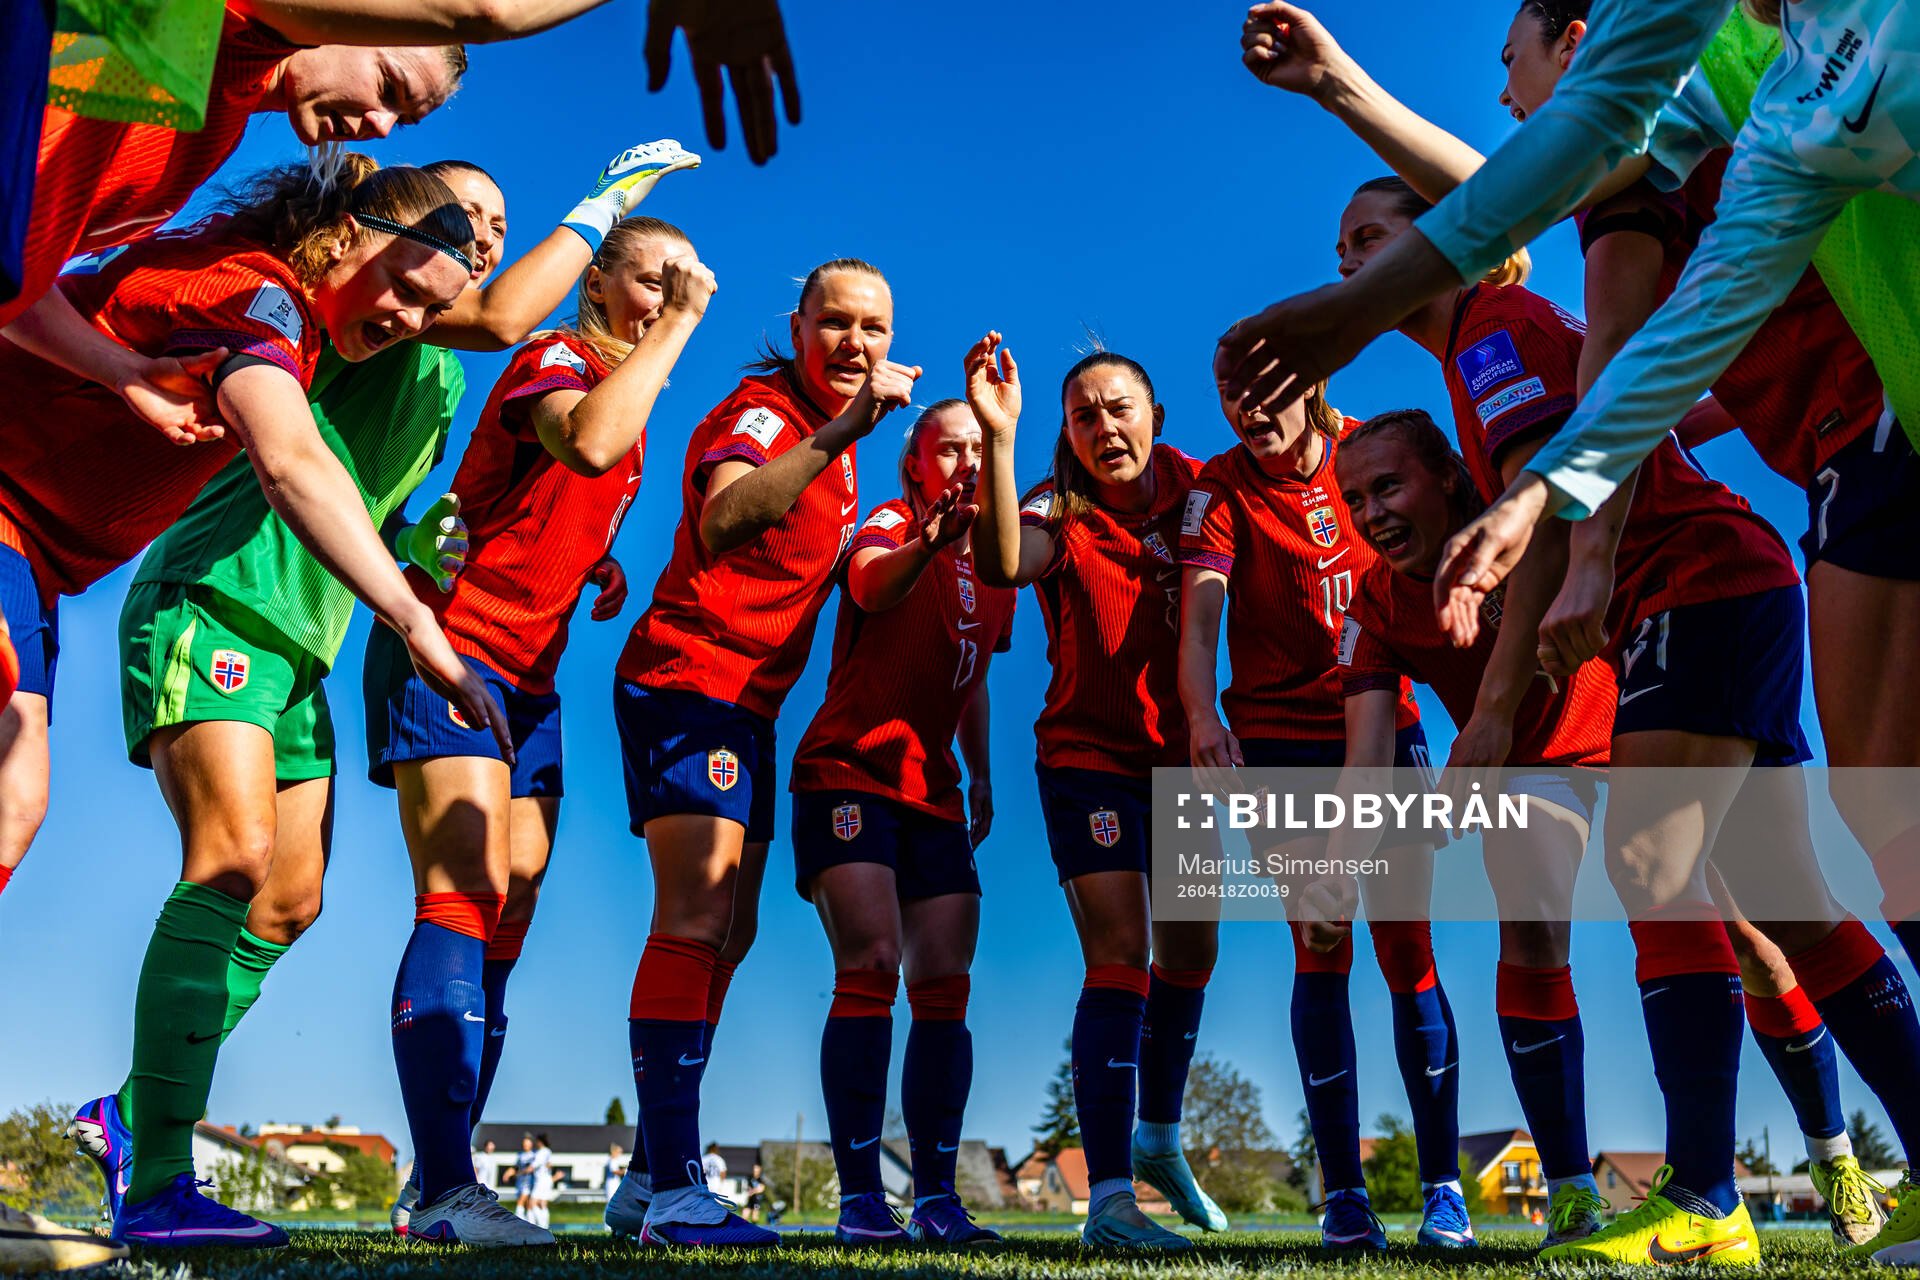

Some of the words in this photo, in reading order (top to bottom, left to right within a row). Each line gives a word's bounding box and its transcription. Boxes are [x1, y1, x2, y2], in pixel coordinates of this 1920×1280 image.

[1835, 28, 1855, 56] mini
[1844, 38, 1863, 63] pris
[1796, 57, 1847, 104] KIWI
[1471, 358, 1514, 386] EUROPEAN
[1472, 363, 1517, 391] QUALIFIERS
[1480, 382, 1542, 418] OUNDATION
[1319, 570, 1353, 629] 10
[953, 638, 977, 691] 13
